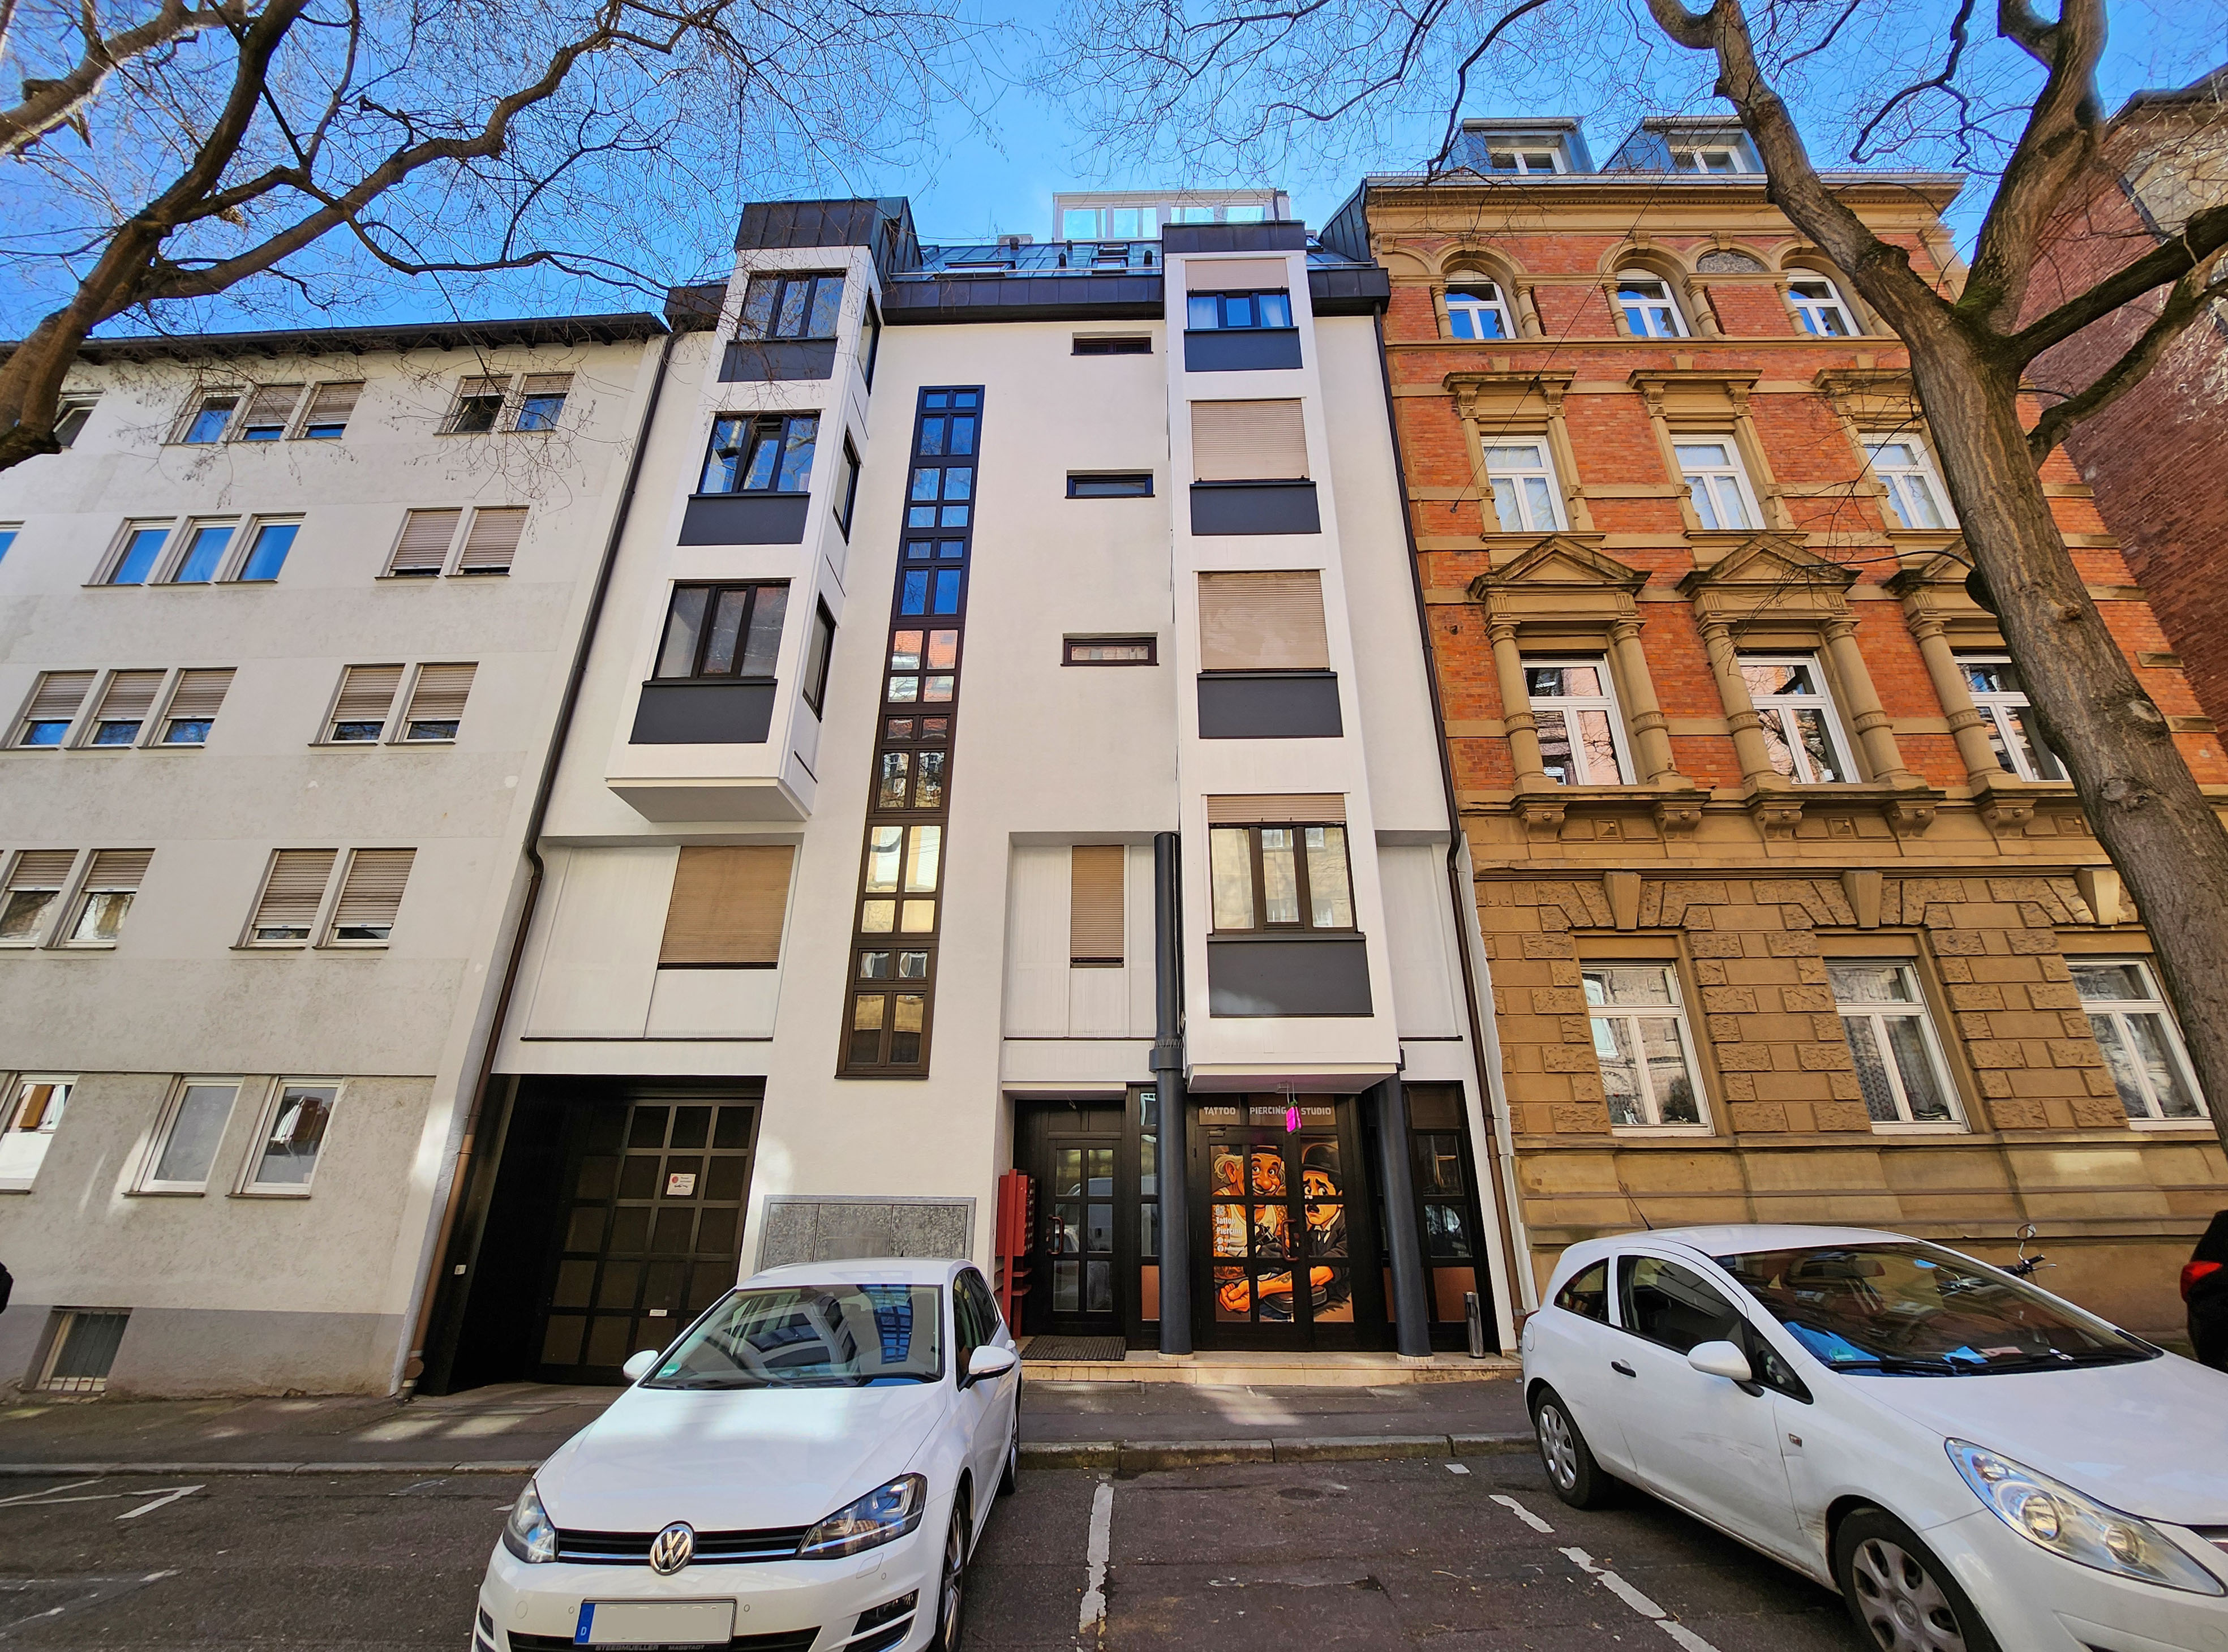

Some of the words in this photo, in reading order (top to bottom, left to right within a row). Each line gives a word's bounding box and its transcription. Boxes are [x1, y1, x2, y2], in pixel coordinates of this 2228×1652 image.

[1204, 1106, 1236, 1115] TATTOO
[1250, 1105, 1287, 1115] PIERCING
[1301, 1106, 1332, 1115] STUDIO
[1217, 1226, 1243, 1236] Piercing
[581, 1626, 587, 1636] D
